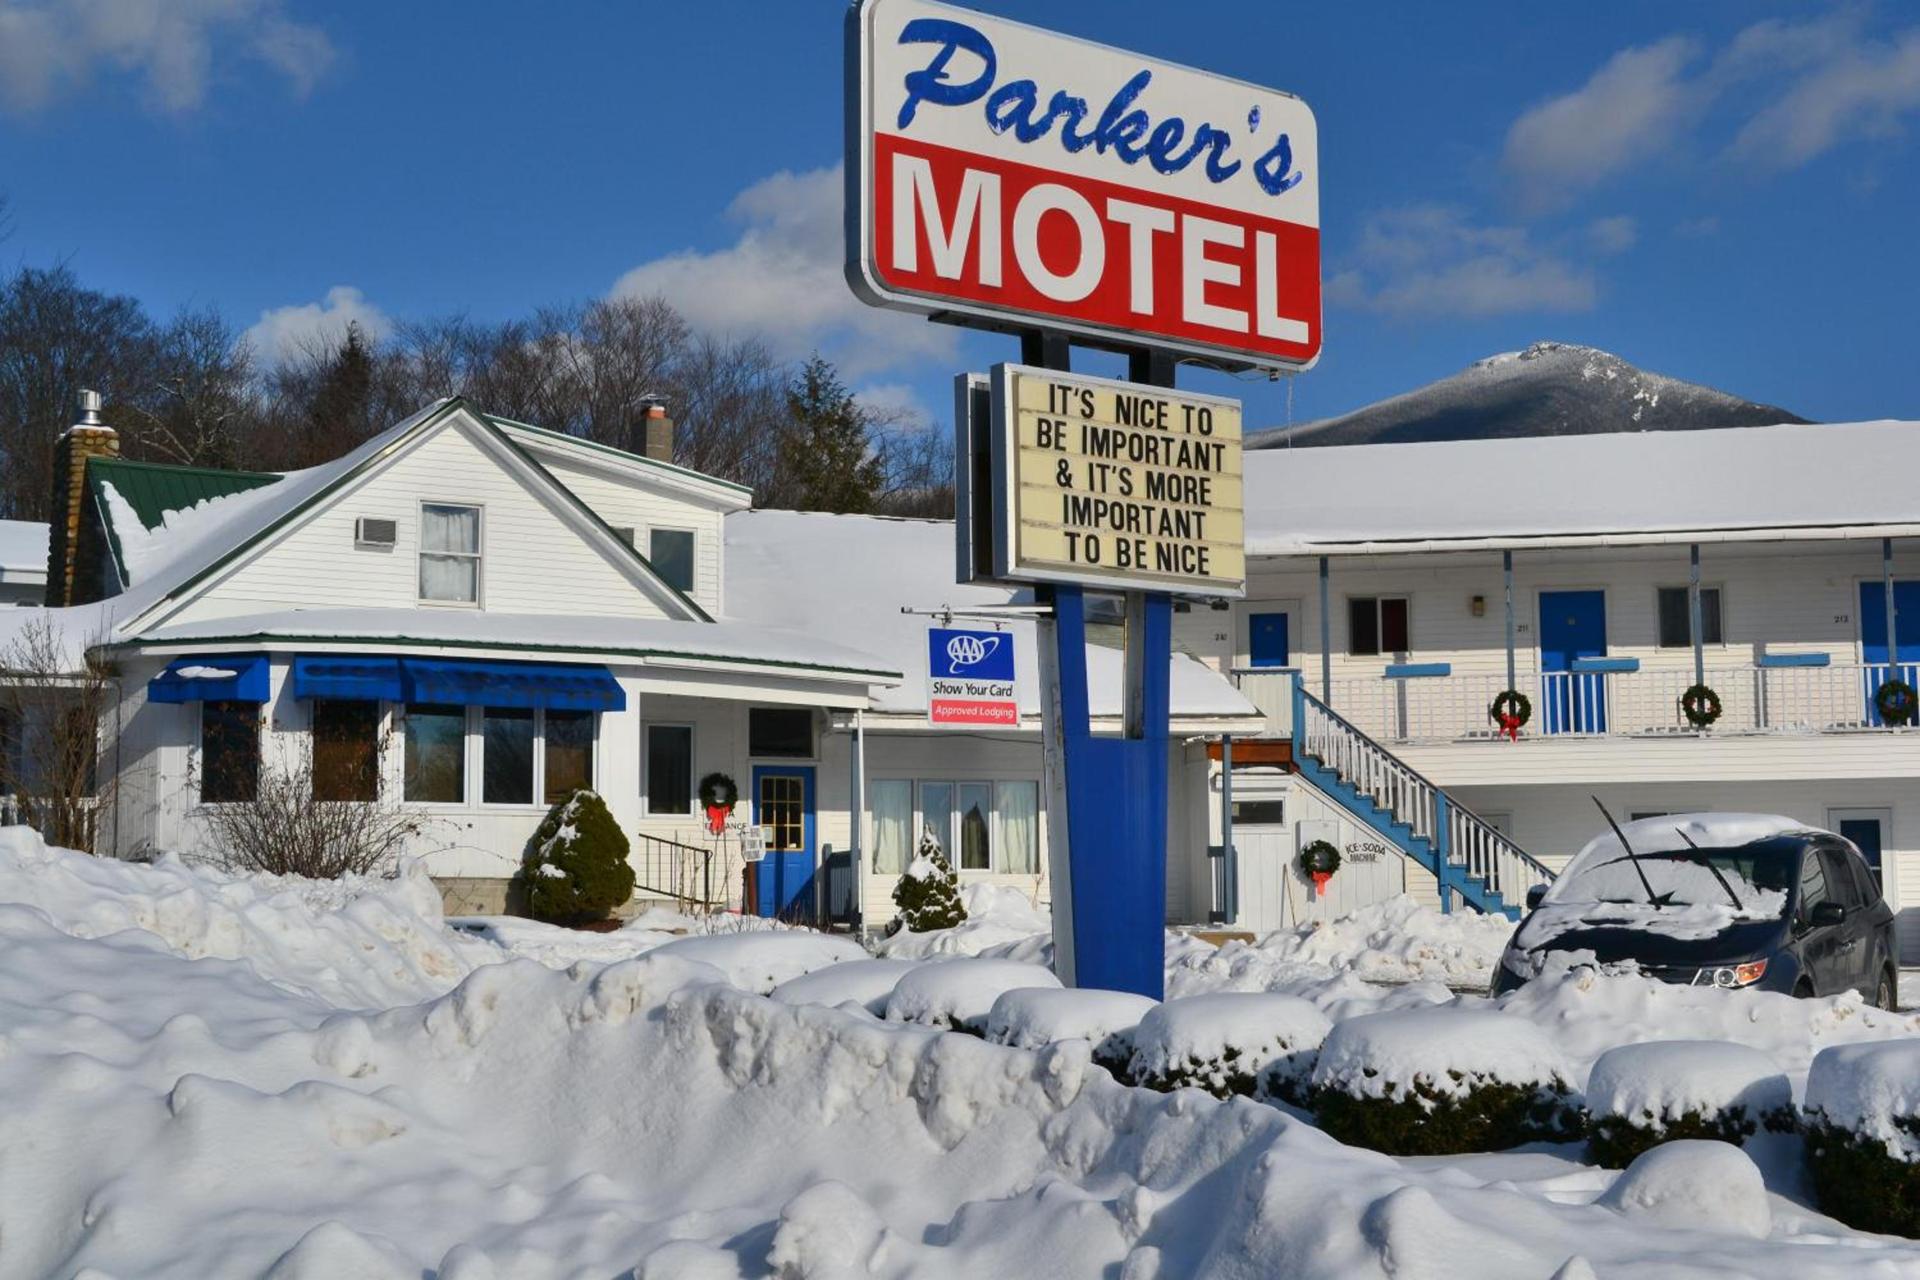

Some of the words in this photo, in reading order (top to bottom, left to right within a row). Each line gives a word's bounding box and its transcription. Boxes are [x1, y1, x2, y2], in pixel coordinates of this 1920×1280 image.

[897, 18, 1303, 197] Parker's
[892, 152, 1309, 344] MOTEL
[1049, 383, 1095, 419] IT'S
[1115, 394, 1169, 431] NICE
[1181, 404, 1213, 436] TO
[1036, 417, 1067, 451] BE
[1081, 425, 1226, 473] IMPORTANT
[1056, 458, 1073, 488] &
[1088, 462, 1133, 496] IT'S
[1145, 470, 1212, 506] MORE
[1063, 494, 1206, 540] IMPORTANT
[1064, 531, 1100, 564] TO
[1116, 537, 1148, 570] BE
[1156, 541, 1210, 576] NICE
[949, 637, 983, 663] AAA
[933, 681, 963, 695] Show
[965, 682, 988, 696] Your
[989, 684, 1014, 697] Card
[935, 705, 977, 717] Approved
[980, 706, 1014, 719] Lodging
